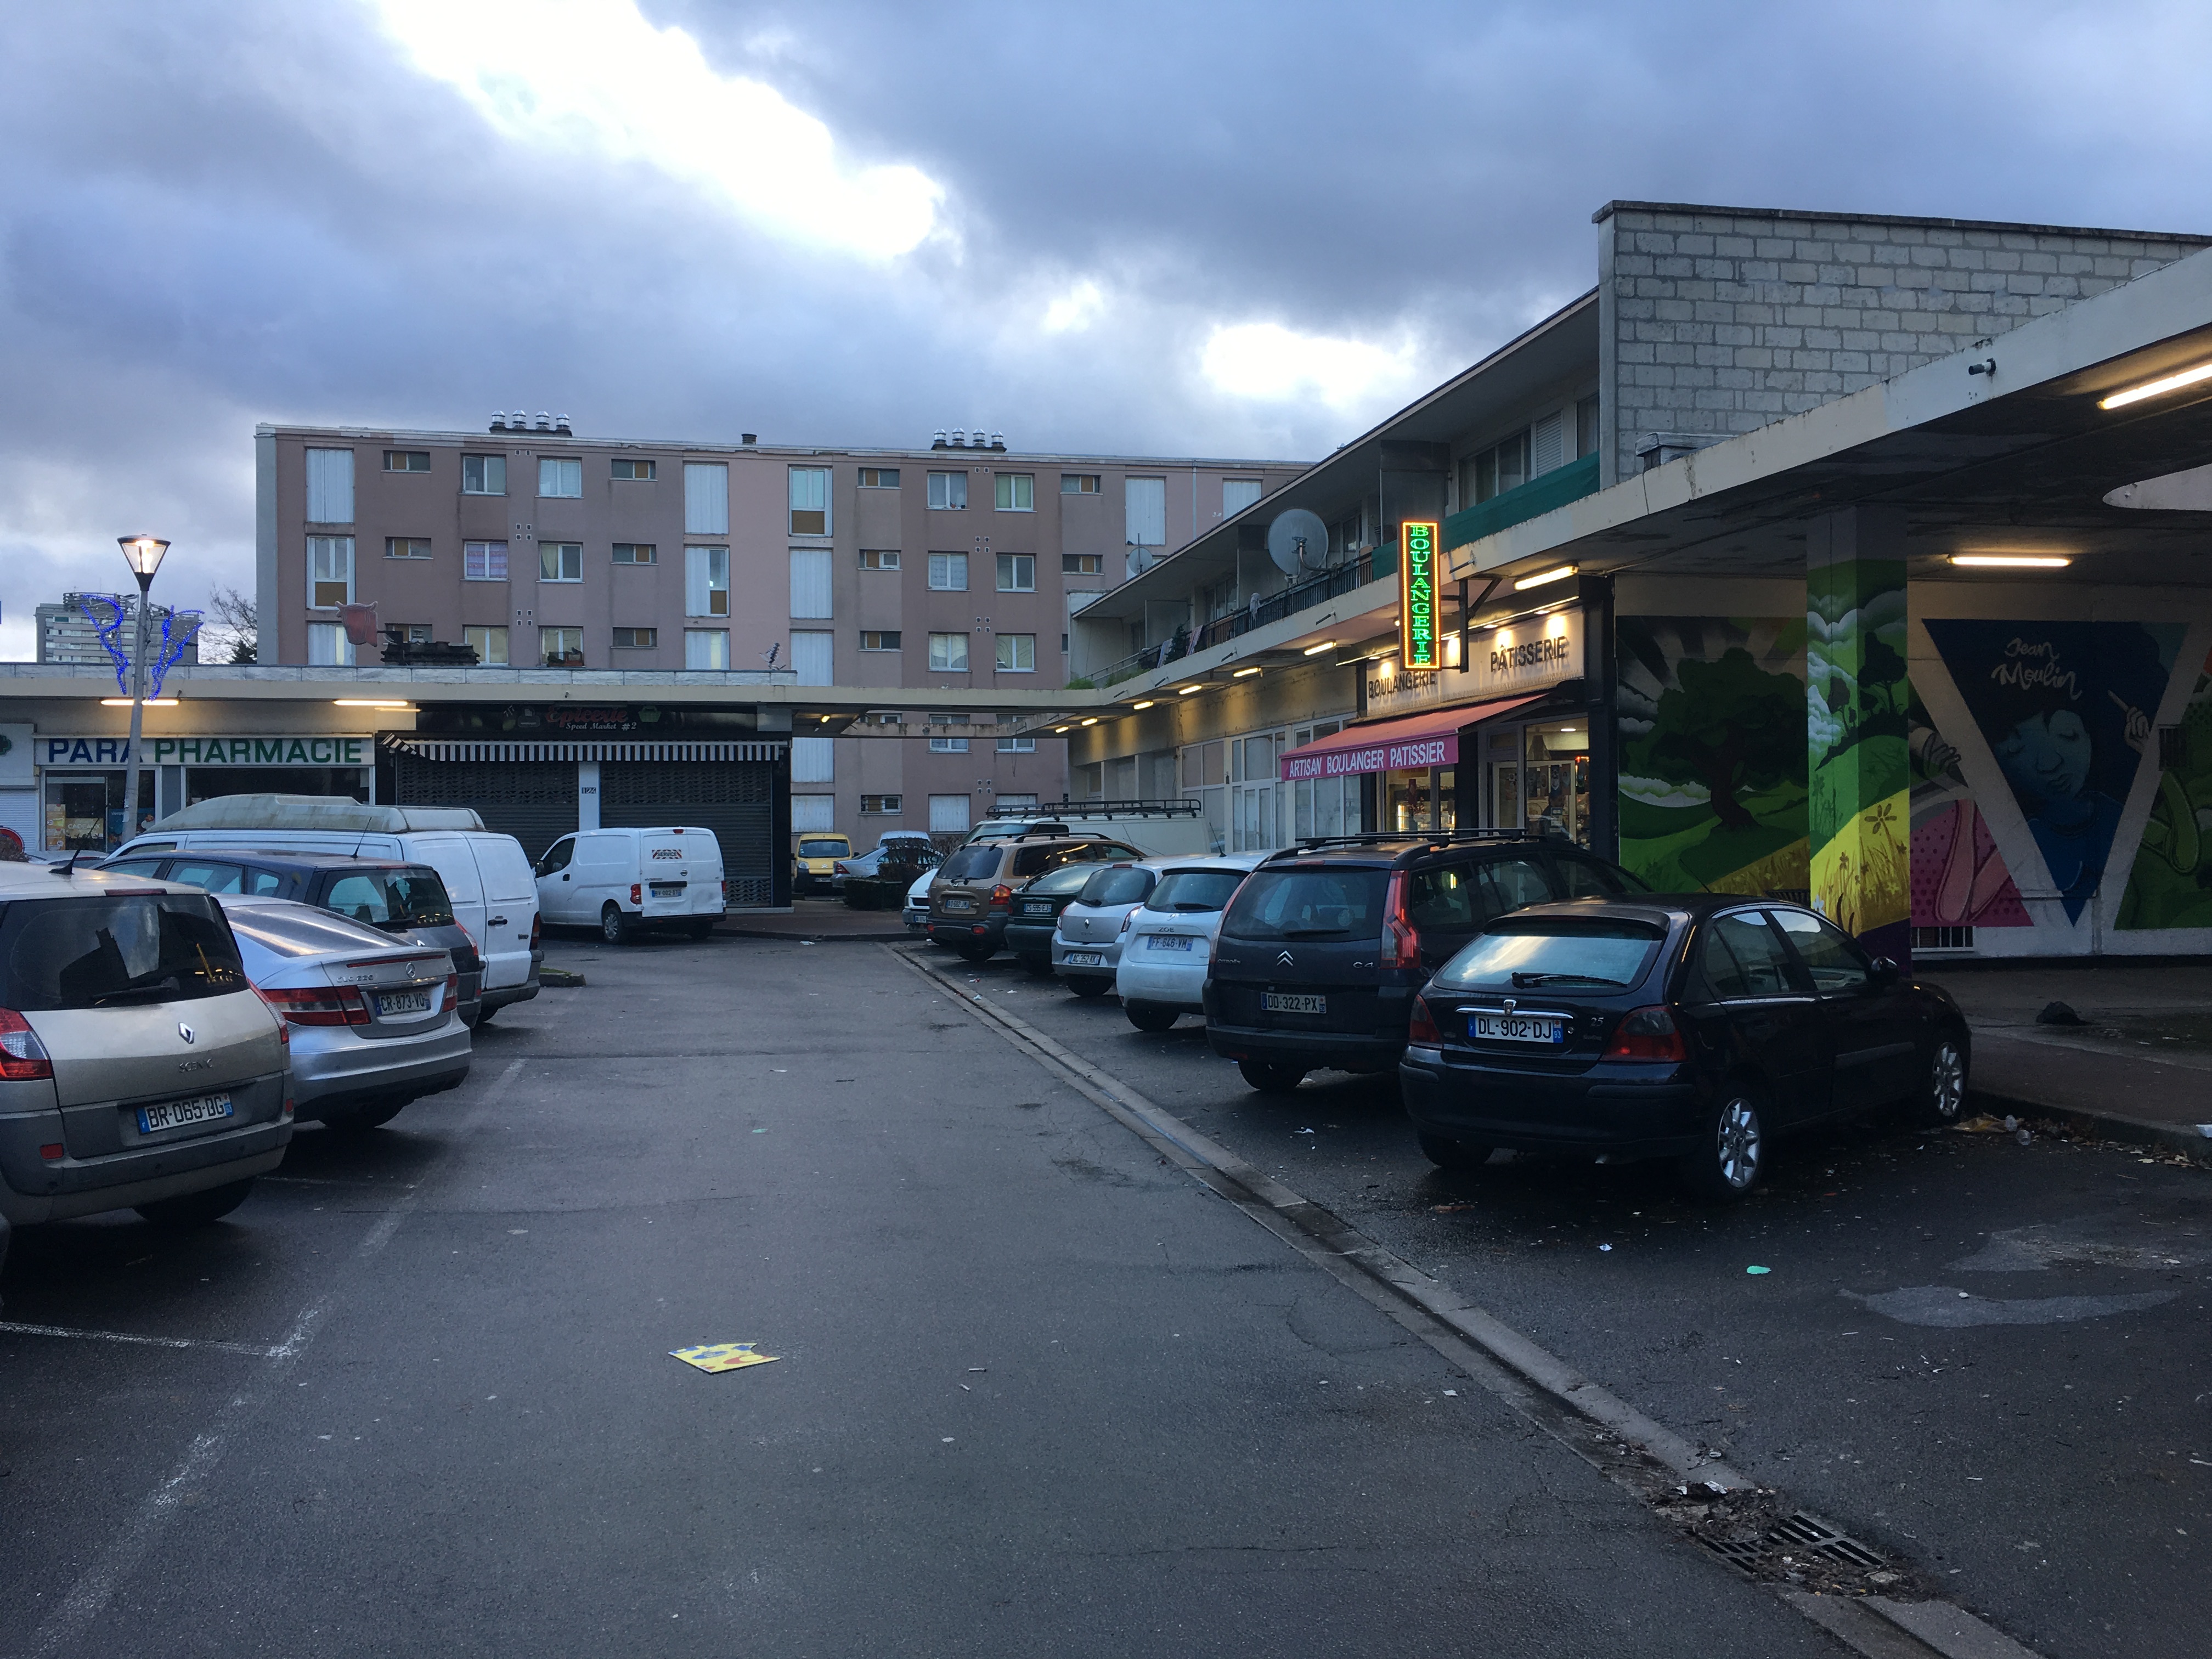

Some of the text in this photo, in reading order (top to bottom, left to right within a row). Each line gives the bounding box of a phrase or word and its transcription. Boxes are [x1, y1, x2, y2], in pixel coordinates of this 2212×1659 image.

[1410, 525, 1432, 665] BOULANGERIE
[2005, 637, 2059, 659] Jean
[1369, 636, 1566, 698] BOULANGERIE PÂTISSERIE
[1991, 661, 2083, 700] Moulin
[566, 722, 587, 730] Speed
[622, 722, 636, 731] #2
[155, 738, 362, 763] PHARMACIE
[1289, 741, 1445, 778] ARTISAN BOULANGER PATISSIER
[1478, 1018, 1551, 1039] DL-902-DJ
[1590, 1017, 1604, 1027] 25
